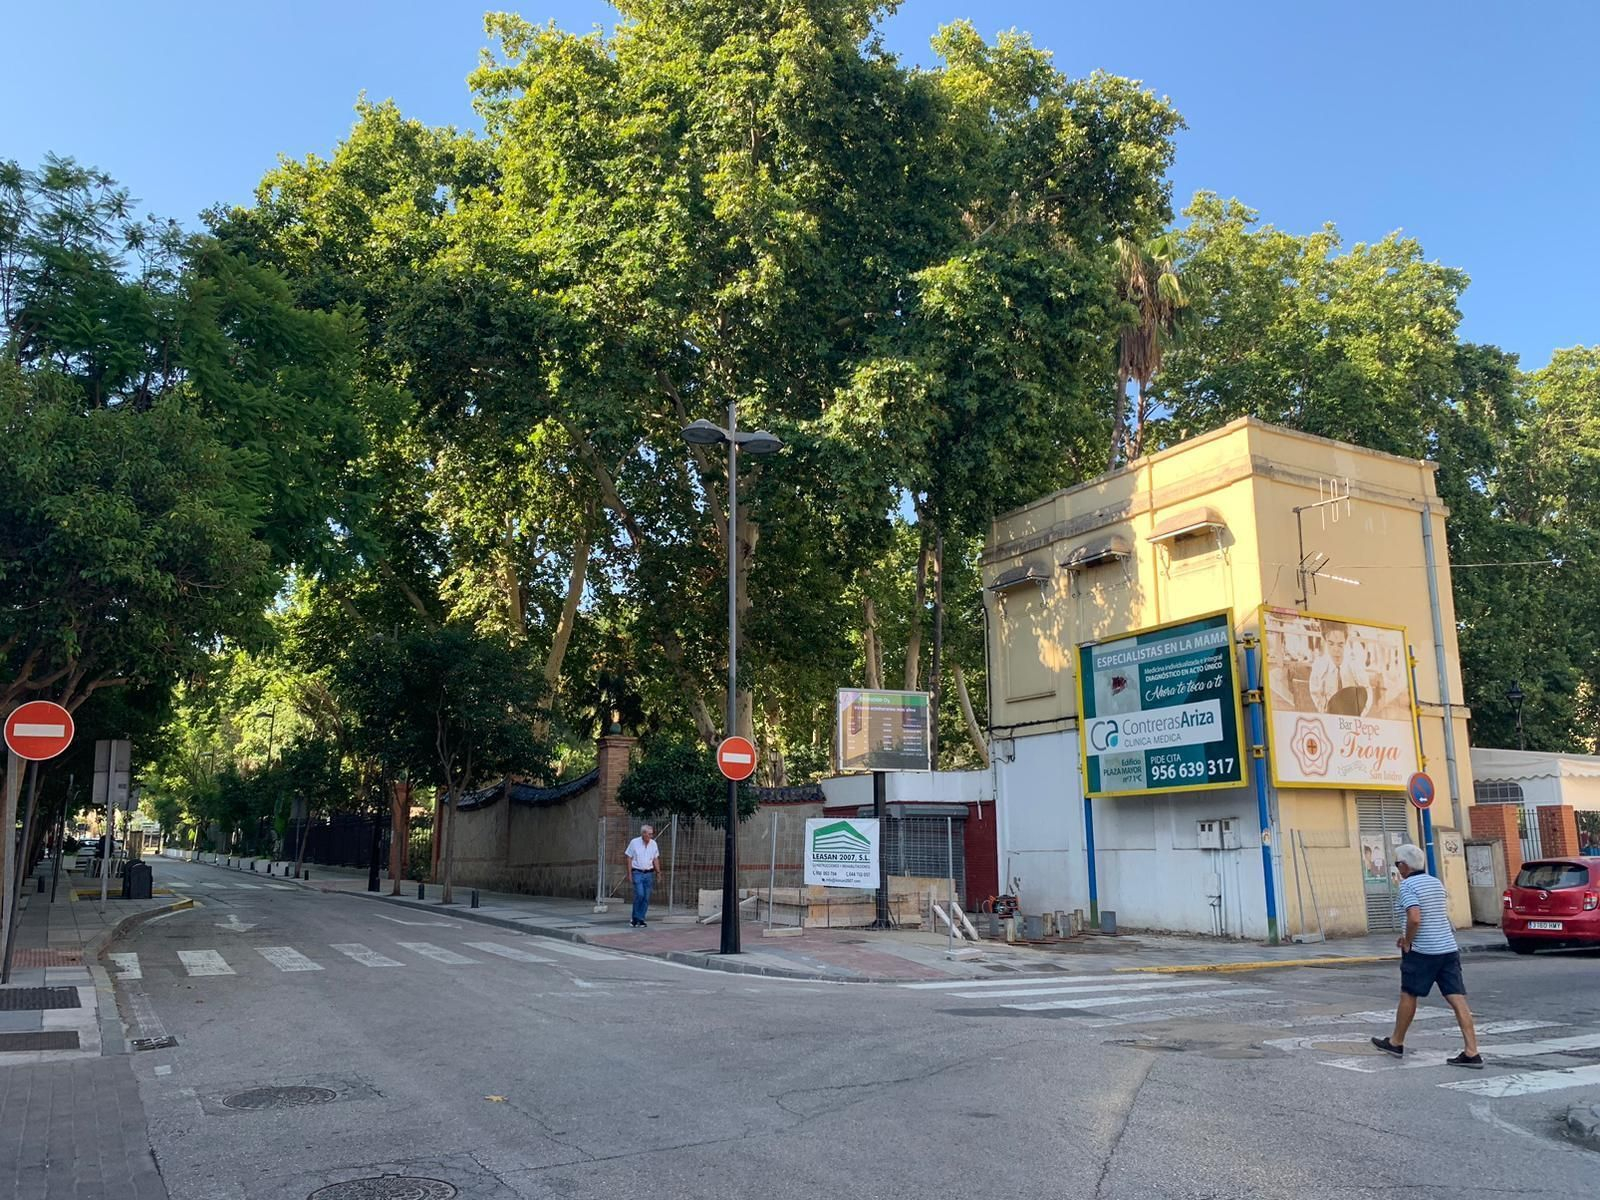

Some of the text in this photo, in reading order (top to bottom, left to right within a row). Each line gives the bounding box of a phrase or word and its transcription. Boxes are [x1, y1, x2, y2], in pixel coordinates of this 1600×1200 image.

[1096, 631, 1227, 669] ESPECIALISTAS EN LA MAMA
[1144, 665, 1165, 675] Medicina
[1165, 659, 1200, 672] individualizada
[1204, 652, 1223, 664] integral
[1145, 670, 1181, 682] DIAGNÓSTICO
[1189, 664, 1204, 674] ACTO
[1204, 661, 1223, 671] ÚNICO
[1145, 674, 1223, 702] Ahora te toca a ti
[1122, 709, 1214, 736] ContrerasAriza
[1338, 717, 1380, 740] Bar Pepe
[1121, 758, 1141, 767] Edificio
[1150, 753, 1182, 765] PIDE CITA
[1340, 732, 1400, 770] Troya
[1103, 765, 1142, 776] PLAZA MAYOR
[1151, 757, 1234, 781] 956 639 317
